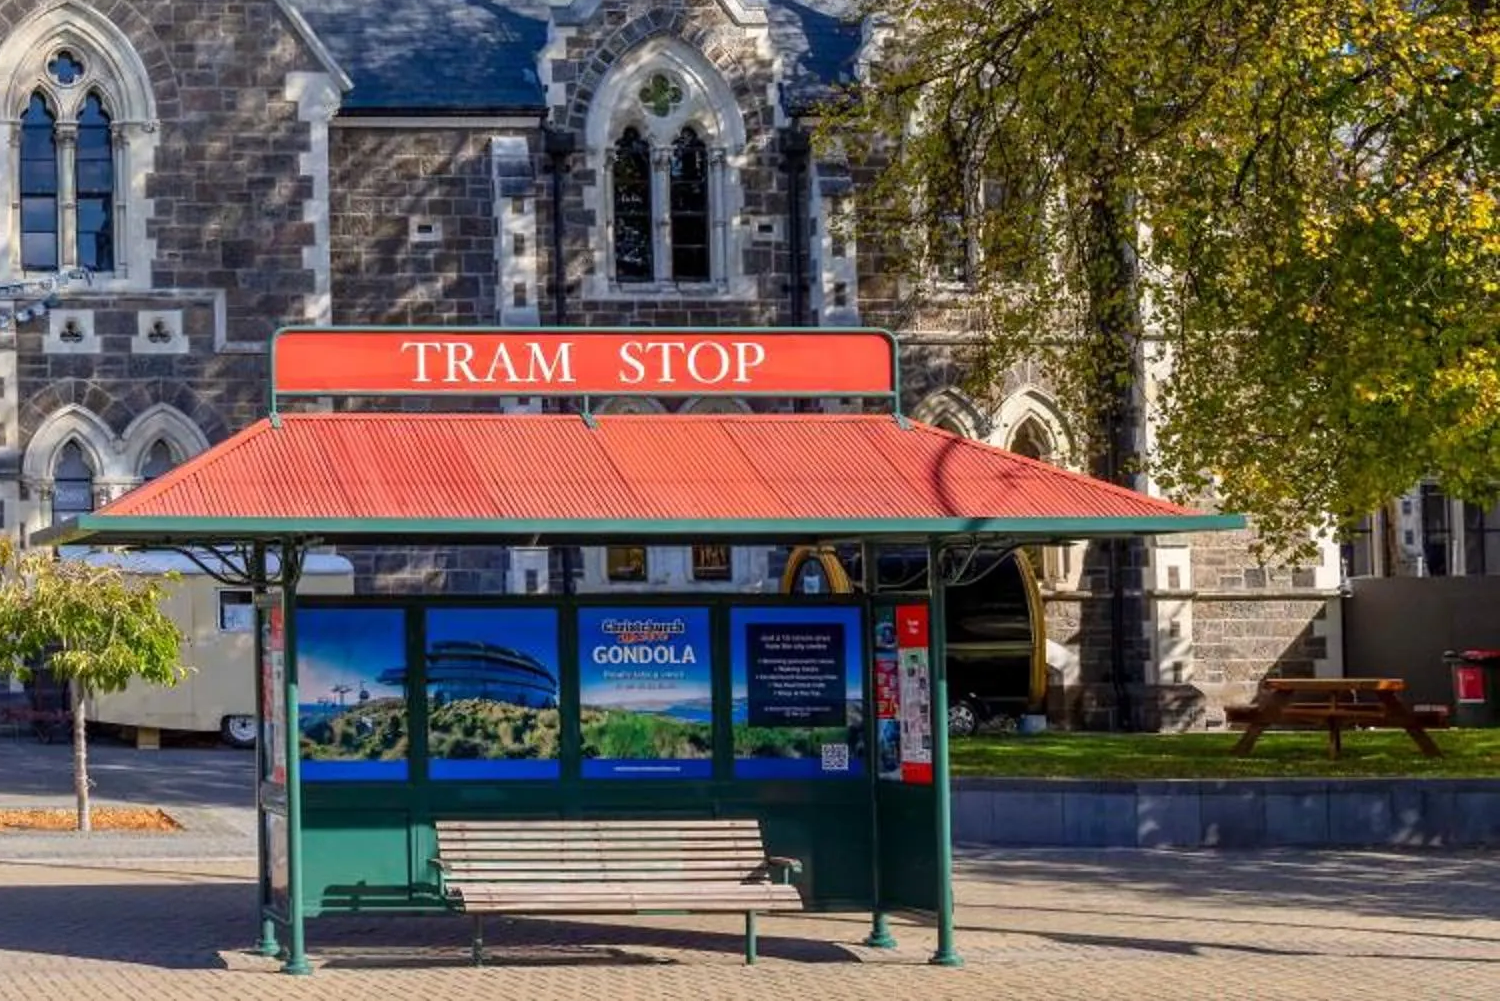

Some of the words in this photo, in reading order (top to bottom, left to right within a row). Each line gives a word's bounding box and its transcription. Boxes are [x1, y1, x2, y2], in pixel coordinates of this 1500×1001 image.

[401, 341, 576, 384] TRAM
[618, 340, 767, 385] STOP
[592, 644, 697, 665] GONDOLA
